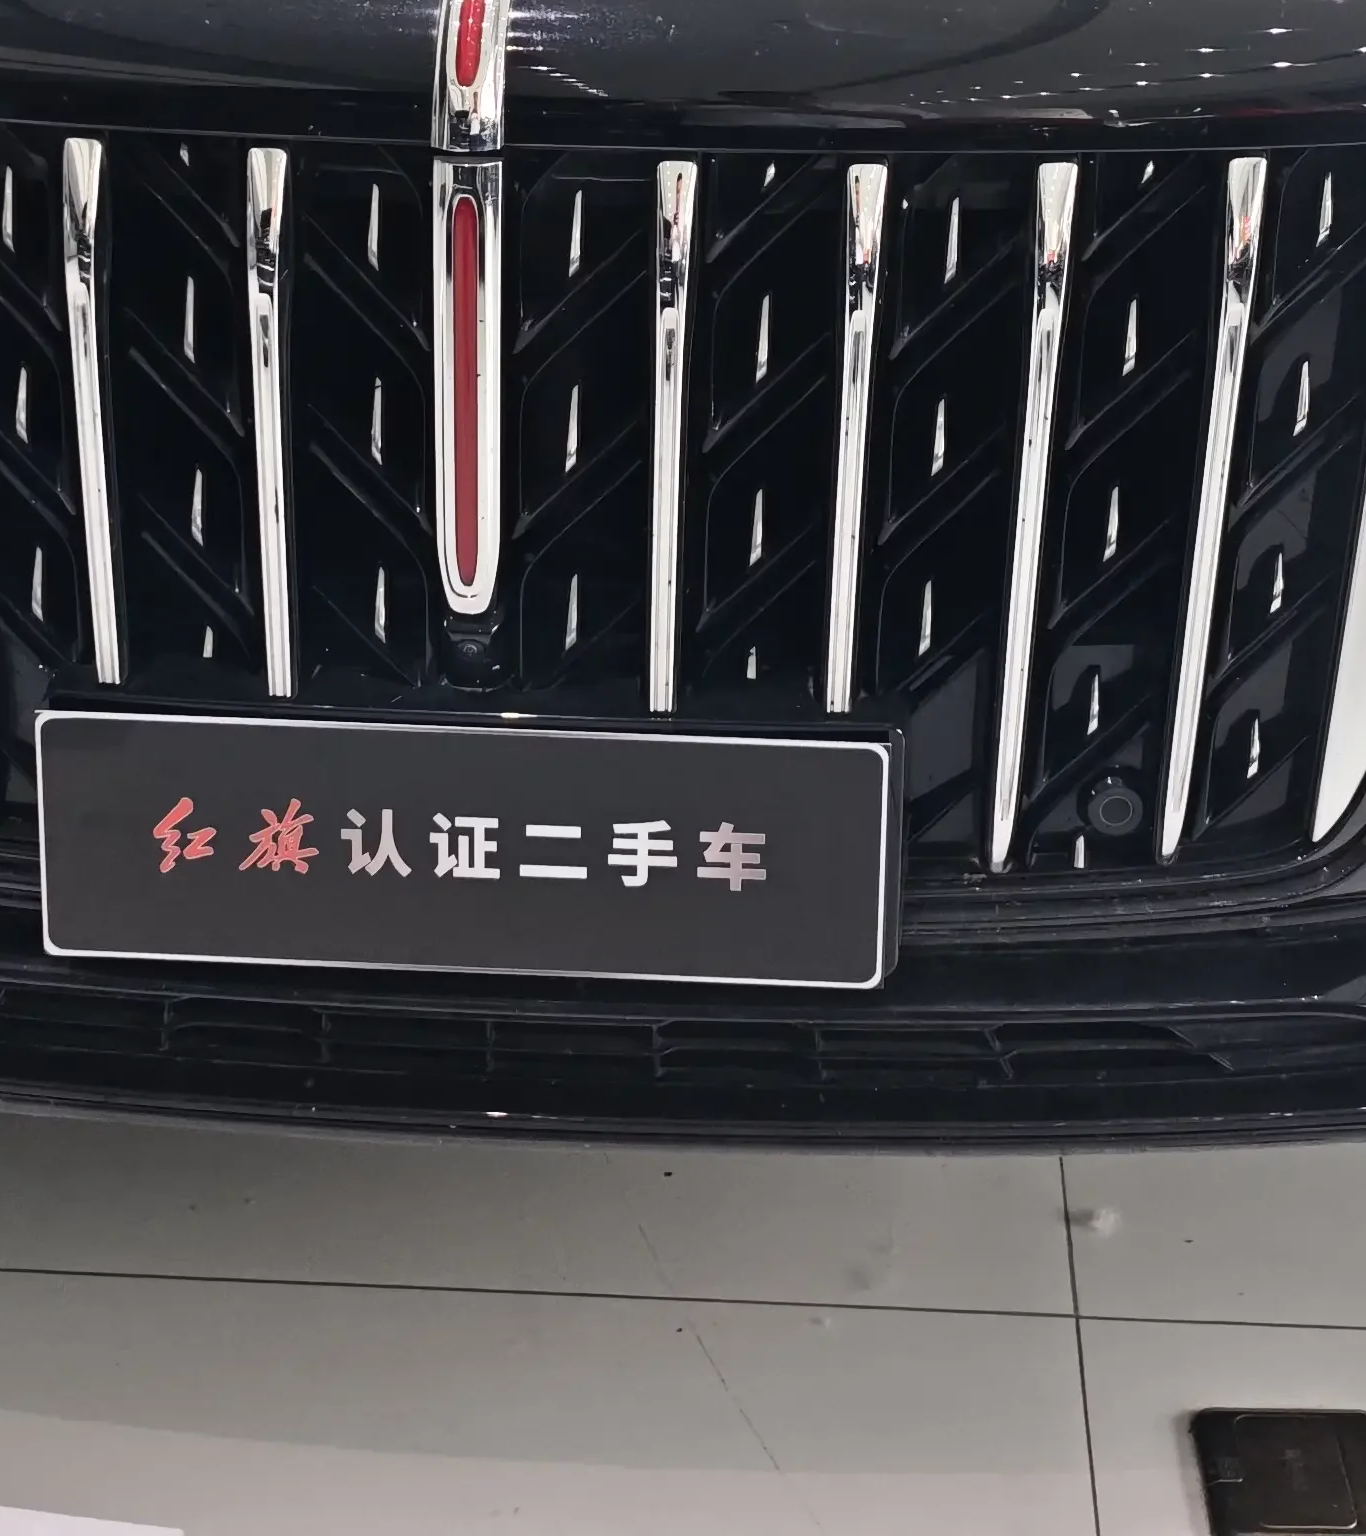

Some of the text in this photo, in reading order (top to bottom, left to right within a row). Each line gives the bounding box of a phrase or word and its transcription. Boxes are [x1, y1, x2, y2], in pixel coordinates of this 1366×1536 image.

[152, 797, 768, 892] 红旗认证二手车
